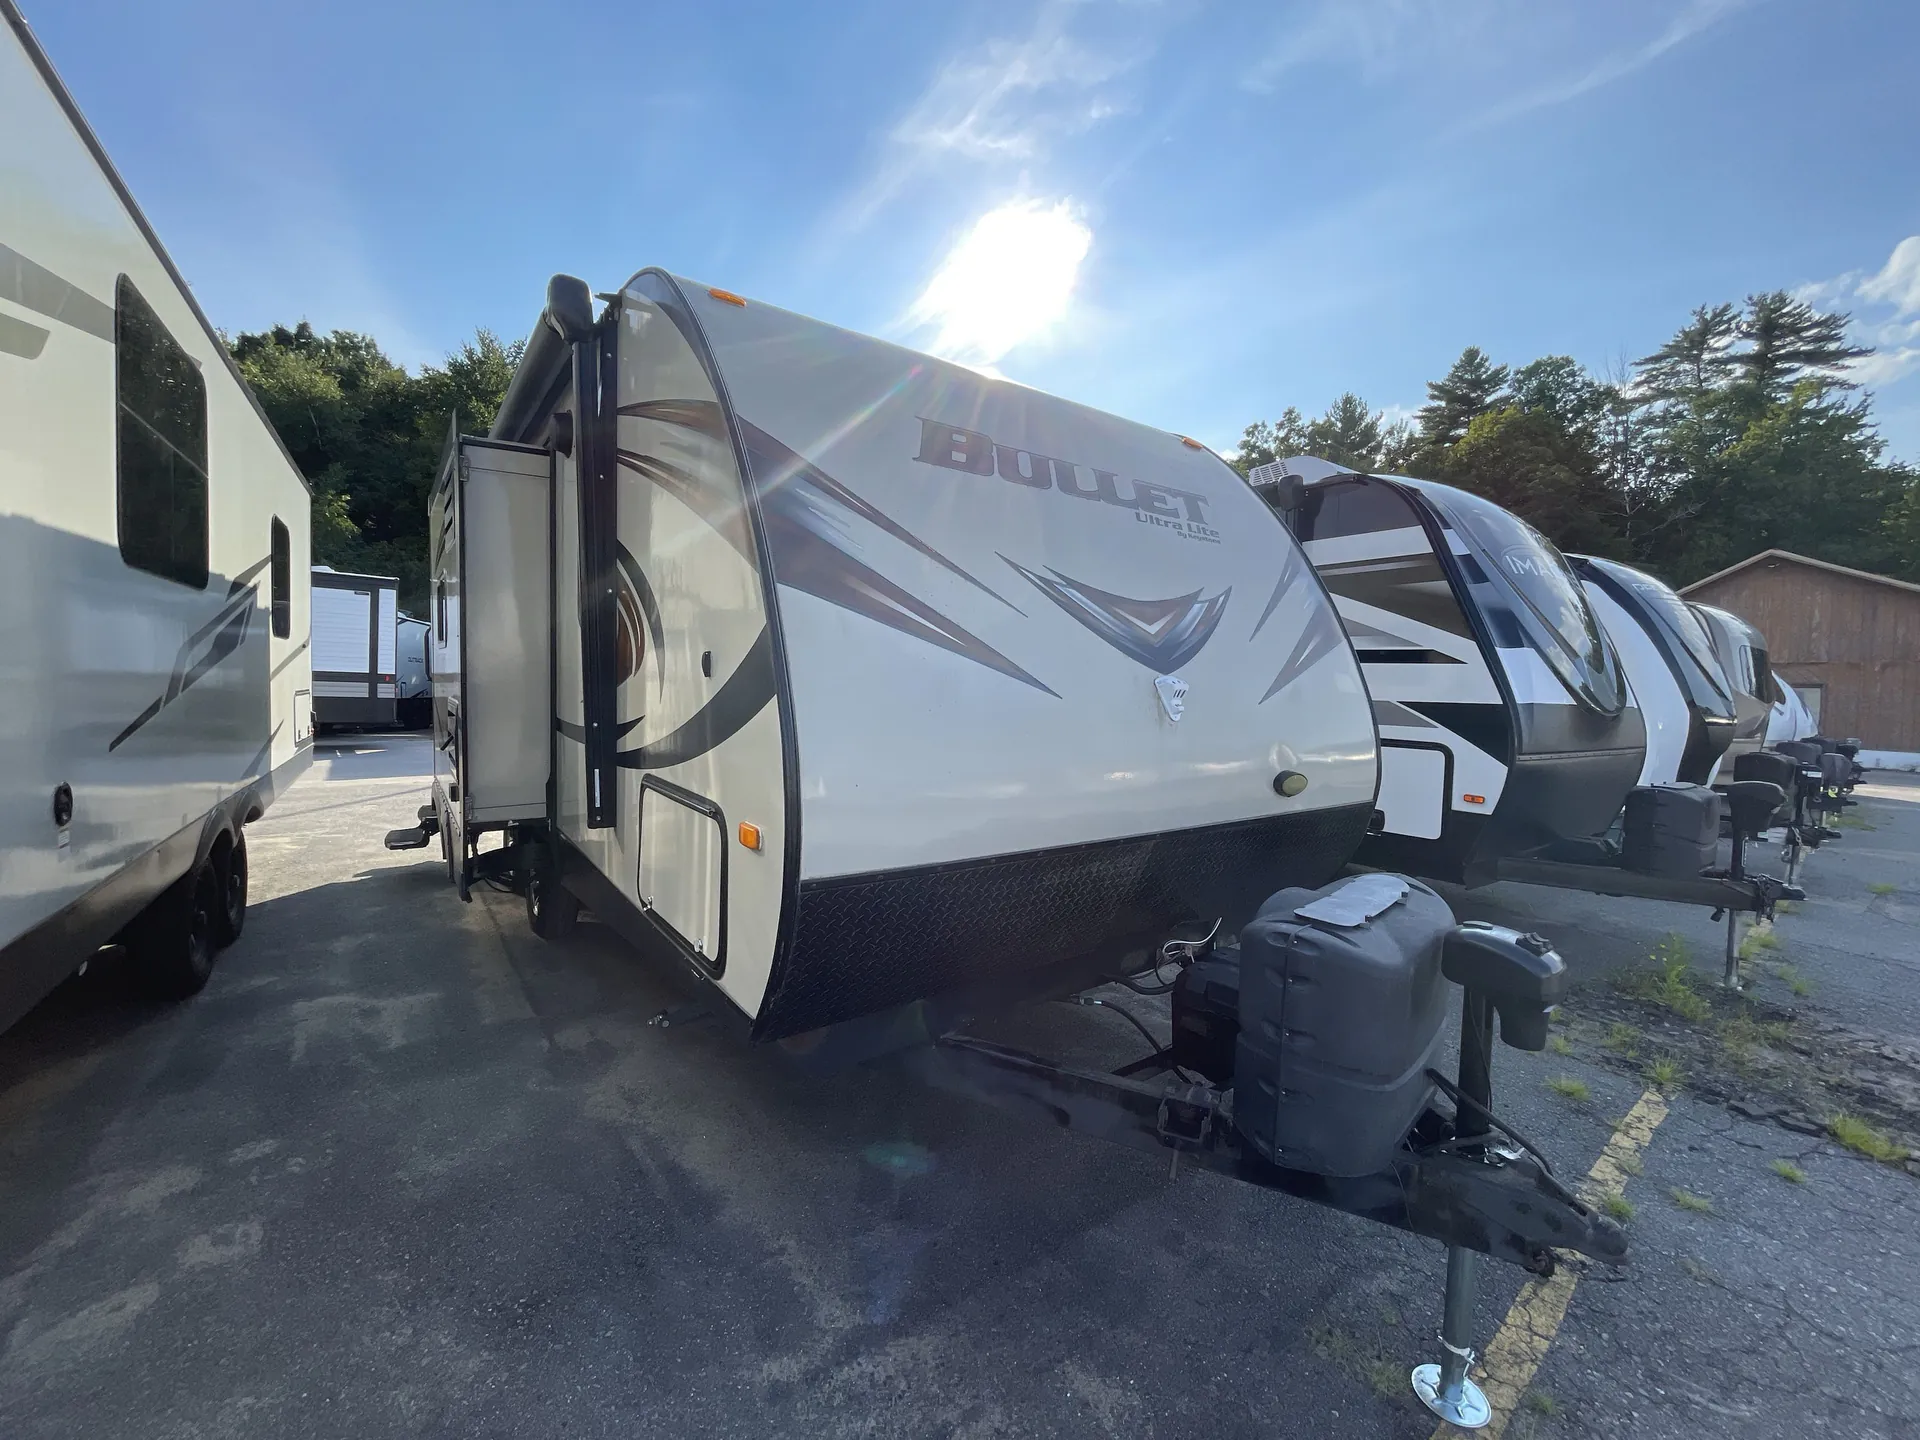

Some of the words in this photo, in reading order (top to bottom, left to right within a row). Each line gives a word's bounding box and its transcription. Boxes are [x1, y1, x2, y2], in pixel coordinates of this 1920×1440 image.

[912, 416, 1210, 525] BULLET
[1135, 512, 1183, 530] Ultra
[1187, 523, 1220, 538] Lite
